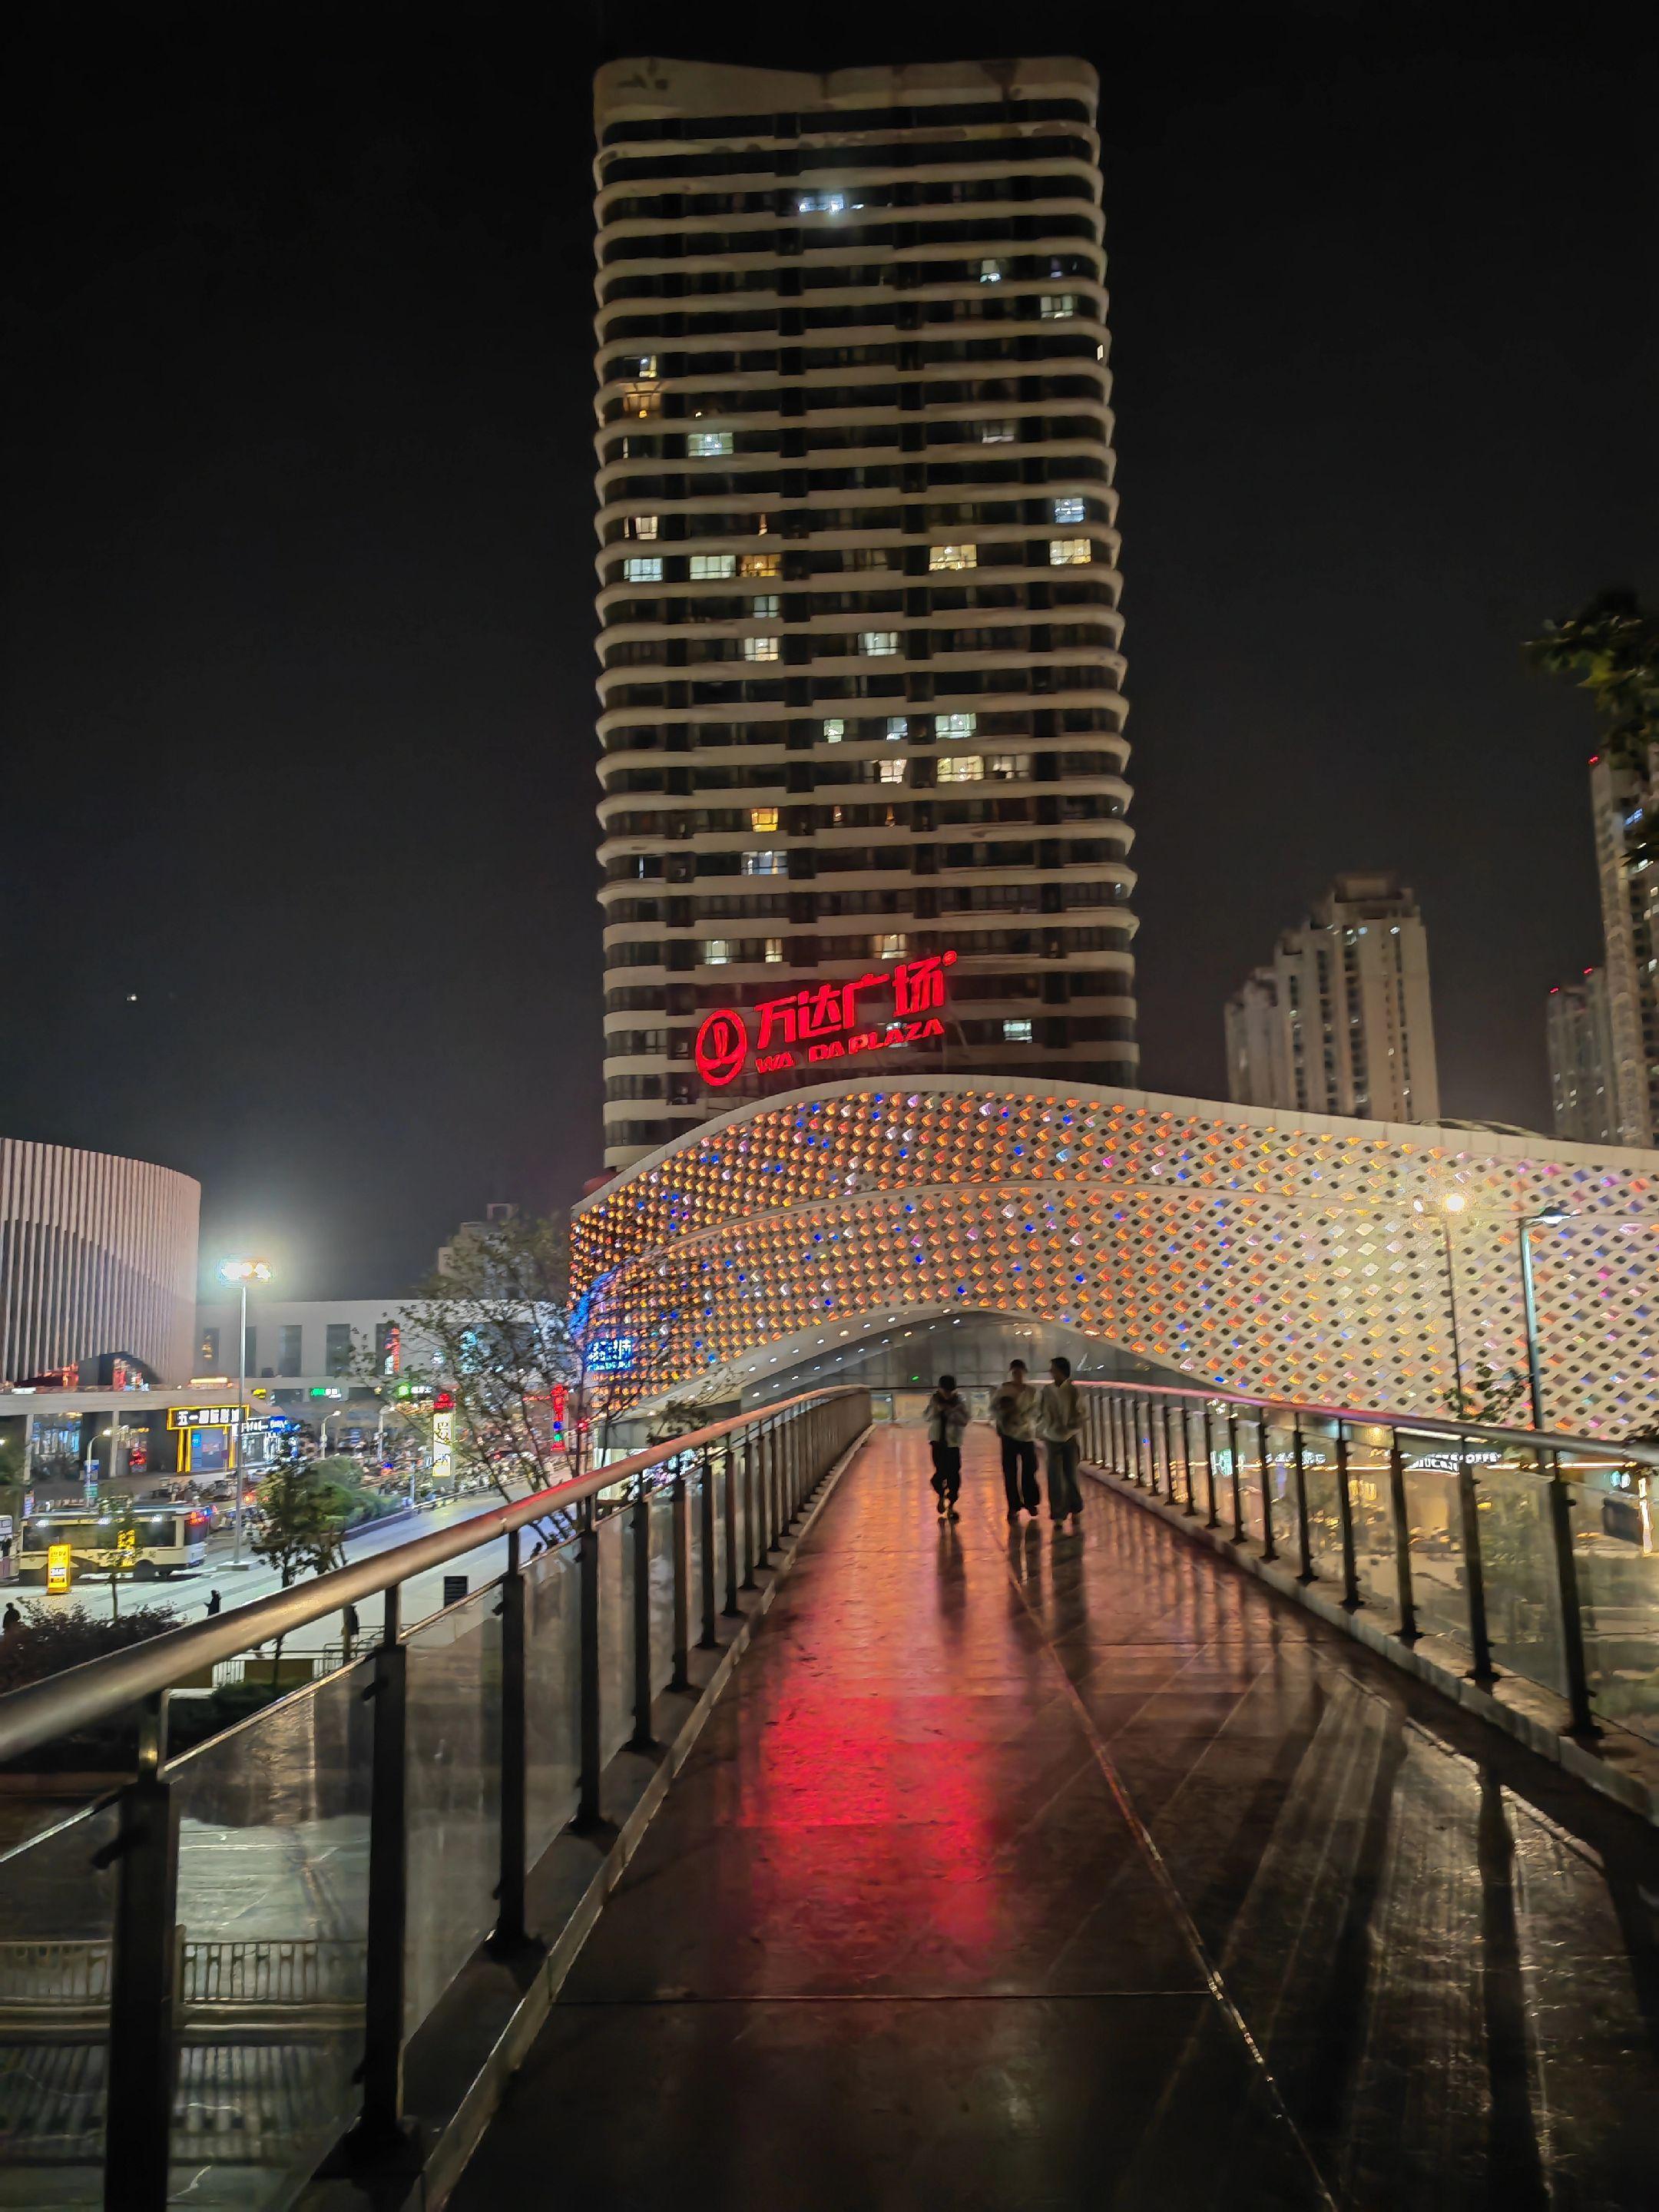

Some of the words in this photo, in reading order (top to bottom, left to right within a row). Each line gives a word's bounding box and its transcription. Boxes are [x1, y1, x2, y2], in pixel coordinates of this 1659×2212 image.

[754, 950, 958, 1050] 万达广场
[808, 1043, 845, 1063] DA
[848, 1018, 945, 1055] PLAZA
